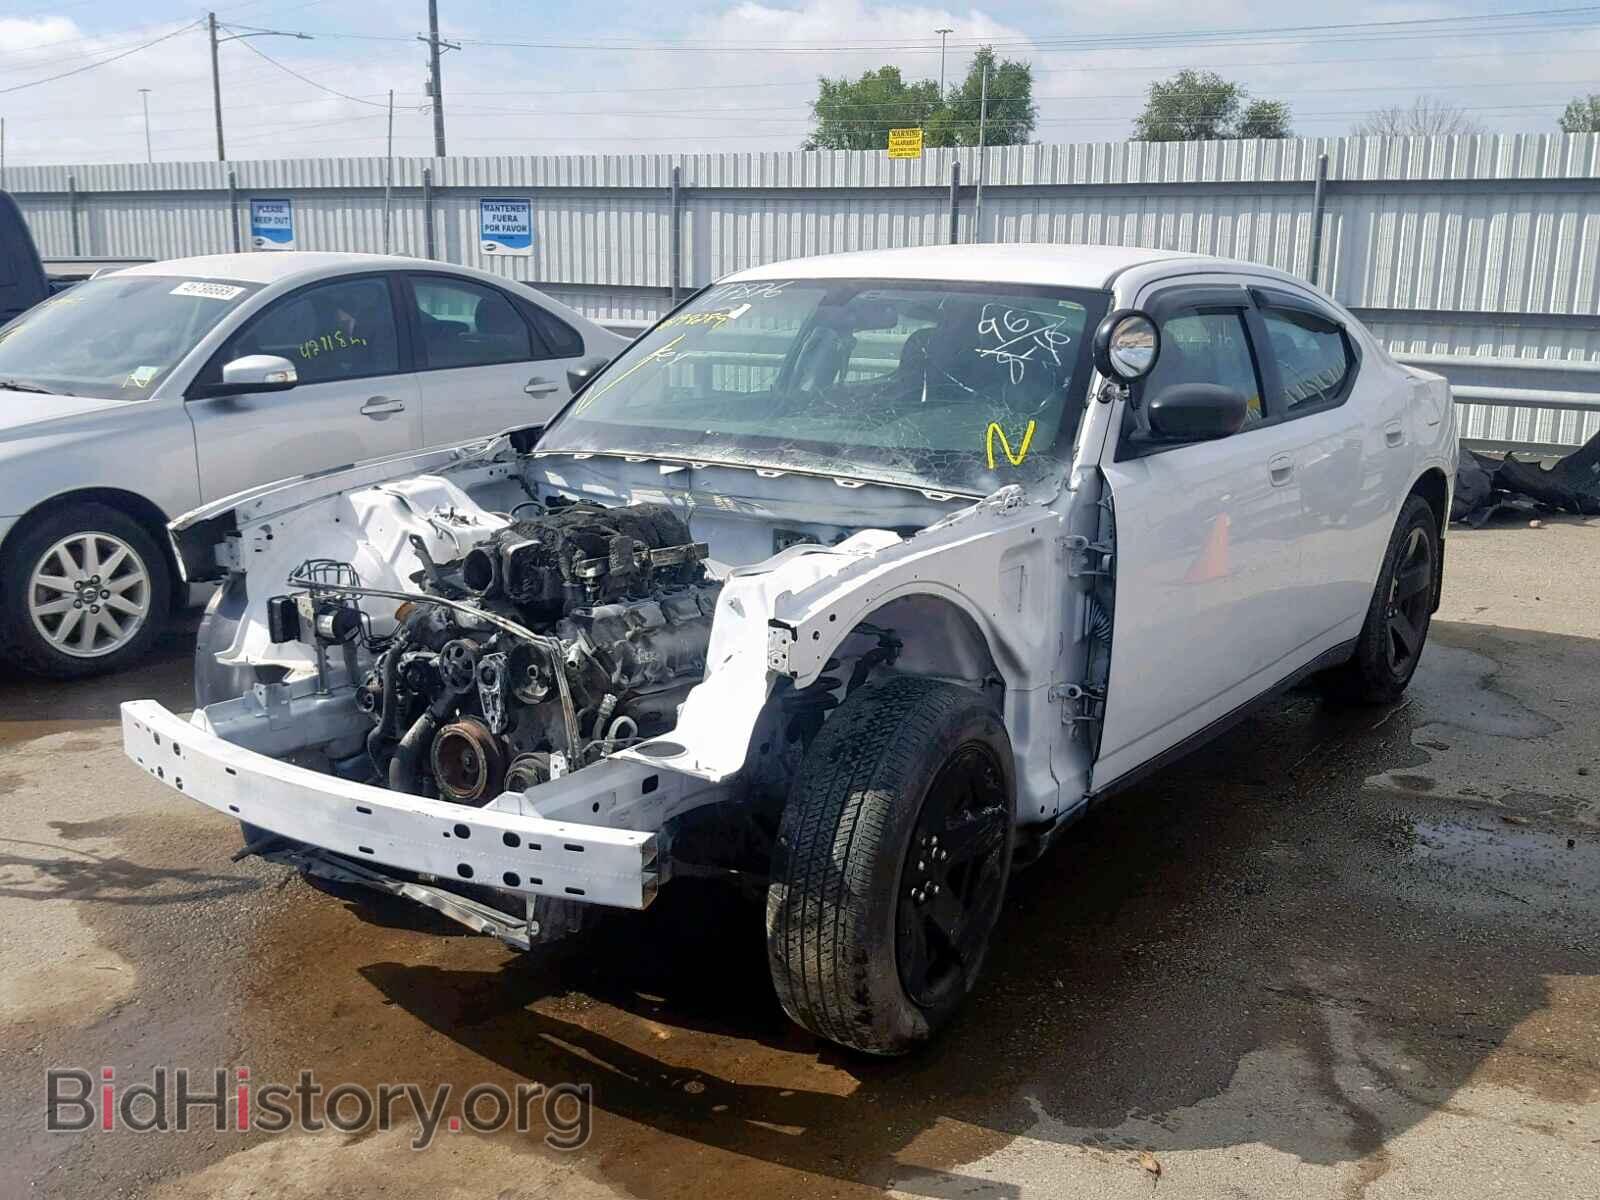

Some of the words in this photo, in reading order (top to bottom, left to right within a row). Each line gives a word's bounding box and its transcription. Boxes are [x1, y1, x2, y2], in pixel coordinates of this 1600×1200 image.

[483, 204, 527, 213] MANTENER
[255, 216, 272, 224] KEEP
[274, 216, 288, 225] OUT
[492, 214, 519, 223] FUERA
[485, 224, 500, 232] POR
[502, 224, 528, 232] FAVOR
[986, 419, 1036, 470] N
